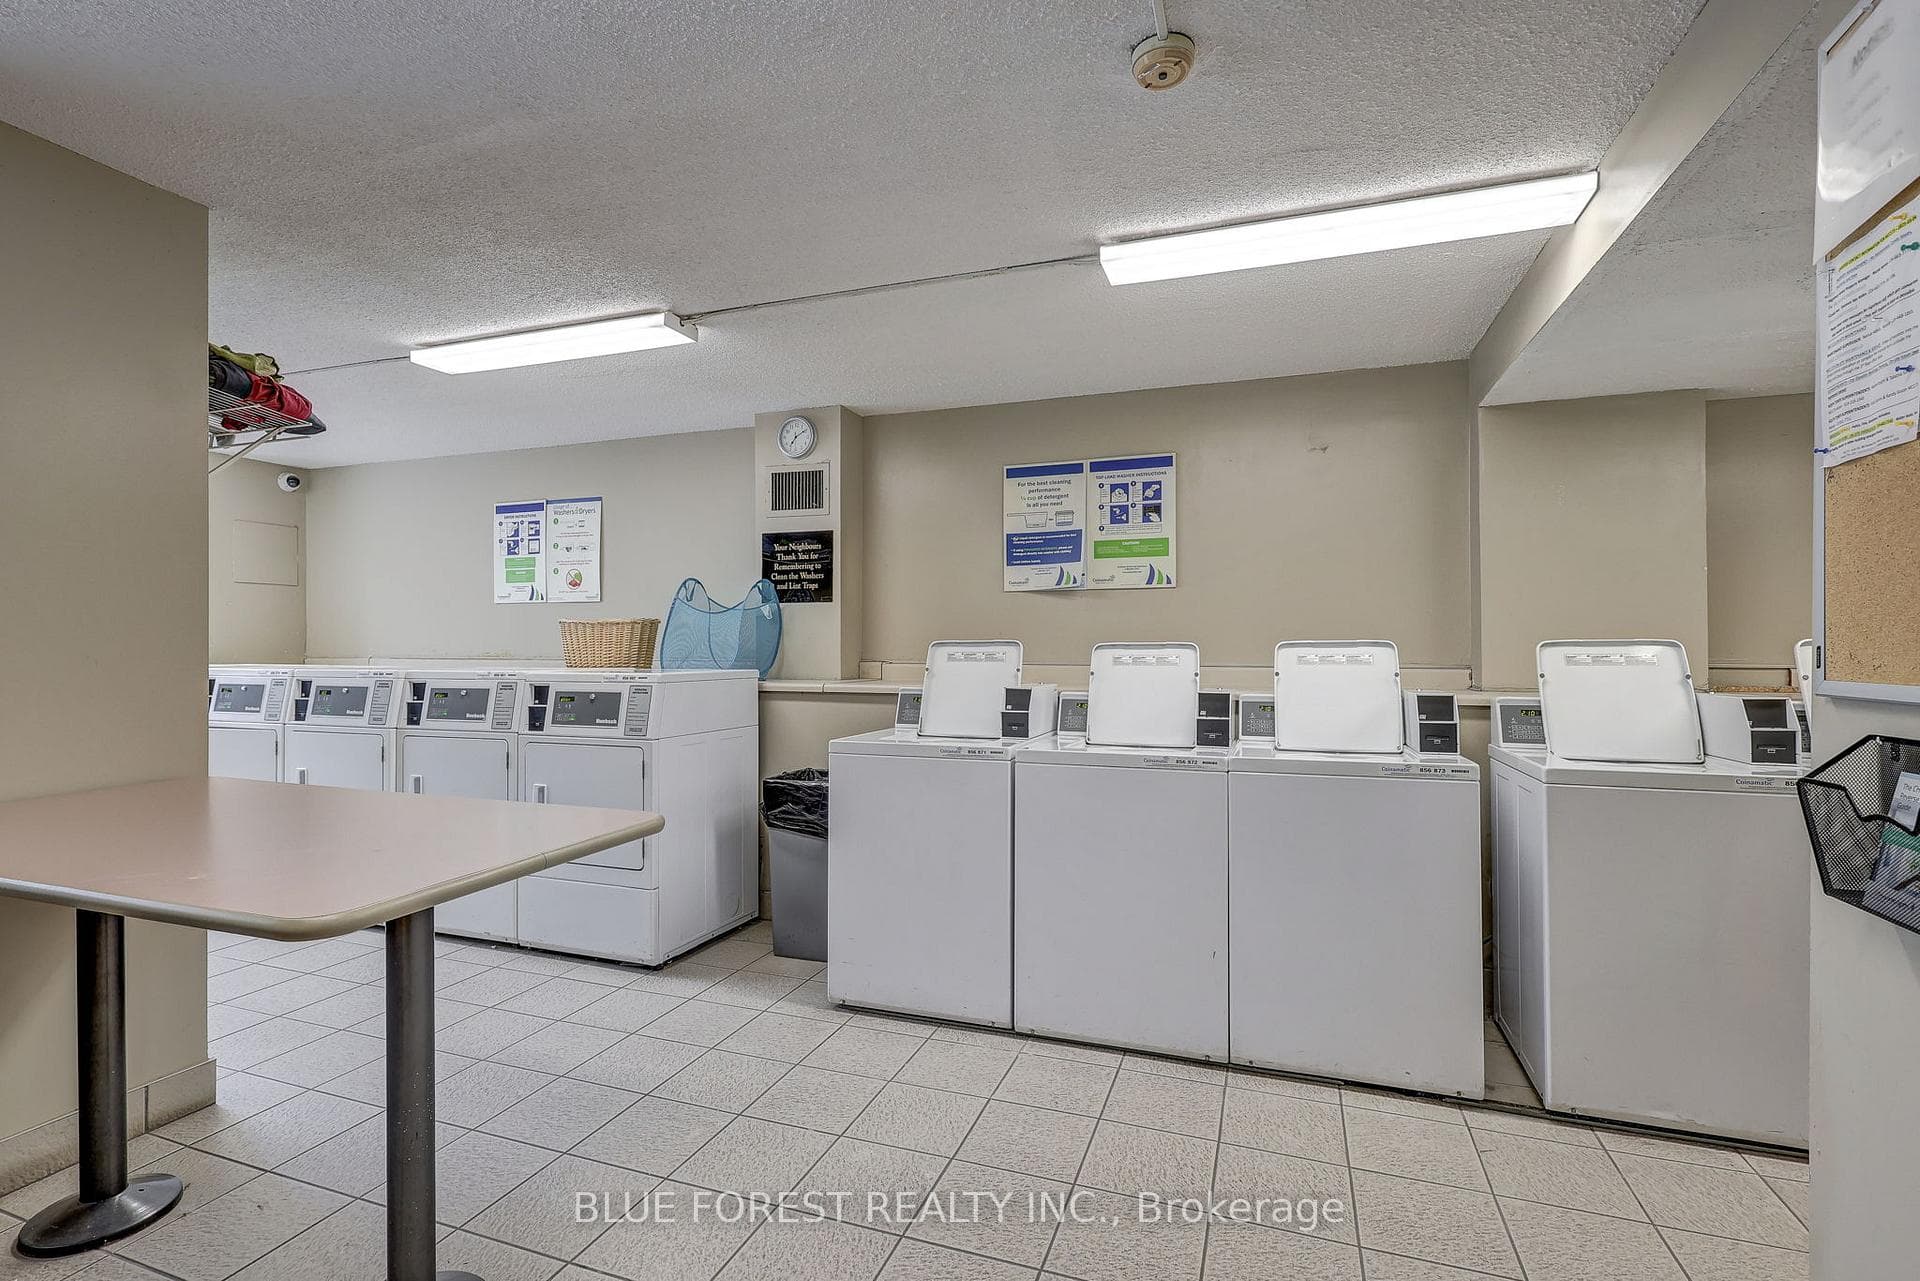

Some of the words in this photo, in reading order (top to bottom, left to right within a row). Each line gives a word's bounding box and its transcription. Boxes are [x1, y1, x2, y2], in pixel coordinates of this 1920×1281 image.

[789, 542, 822, 552] Neighbours
[776, 552, 796, 560] Thank
[774, 562, 814, 570] Remembering
[777, 582, 788, 590] and
[789, 582, 801, 590] Lint
[802, 582, 819, 590] Traps
